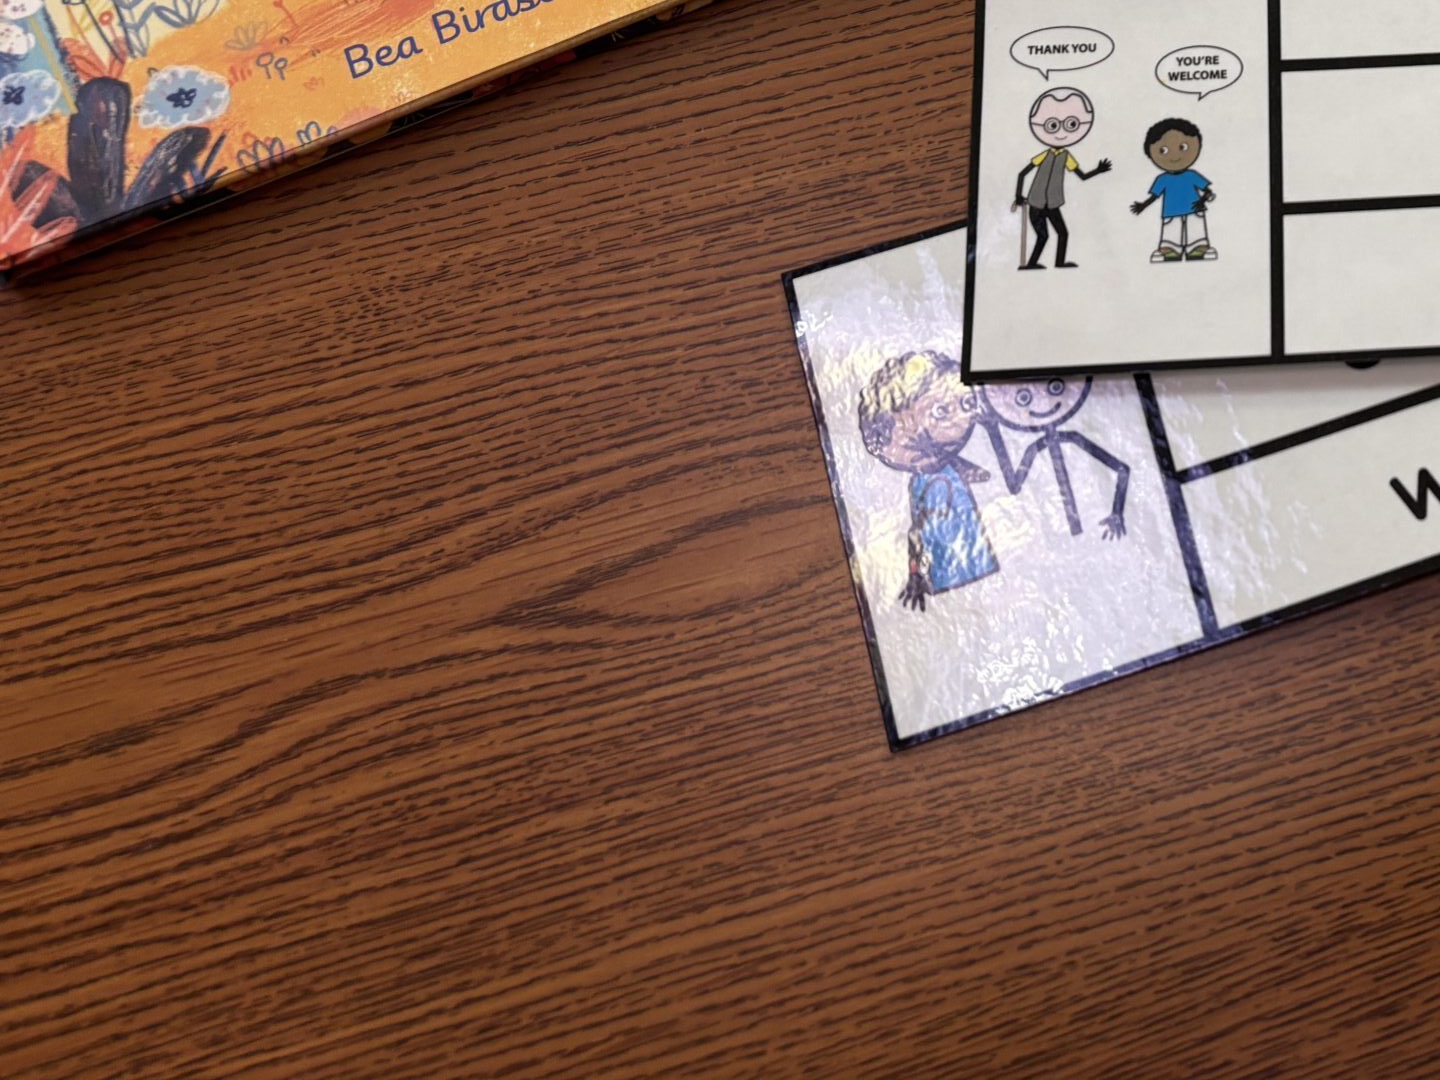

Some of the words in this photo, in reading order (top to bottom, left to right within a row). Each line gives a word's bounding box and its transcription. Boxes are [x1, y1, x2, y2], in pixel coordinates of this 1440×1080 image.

[1027, 44, 1069, 55] THANK
[1071, 43, 1097, 53] YOU
[343, 35, 424, 79] Bea
[1167, 69, 1228, 82] WELCOME
